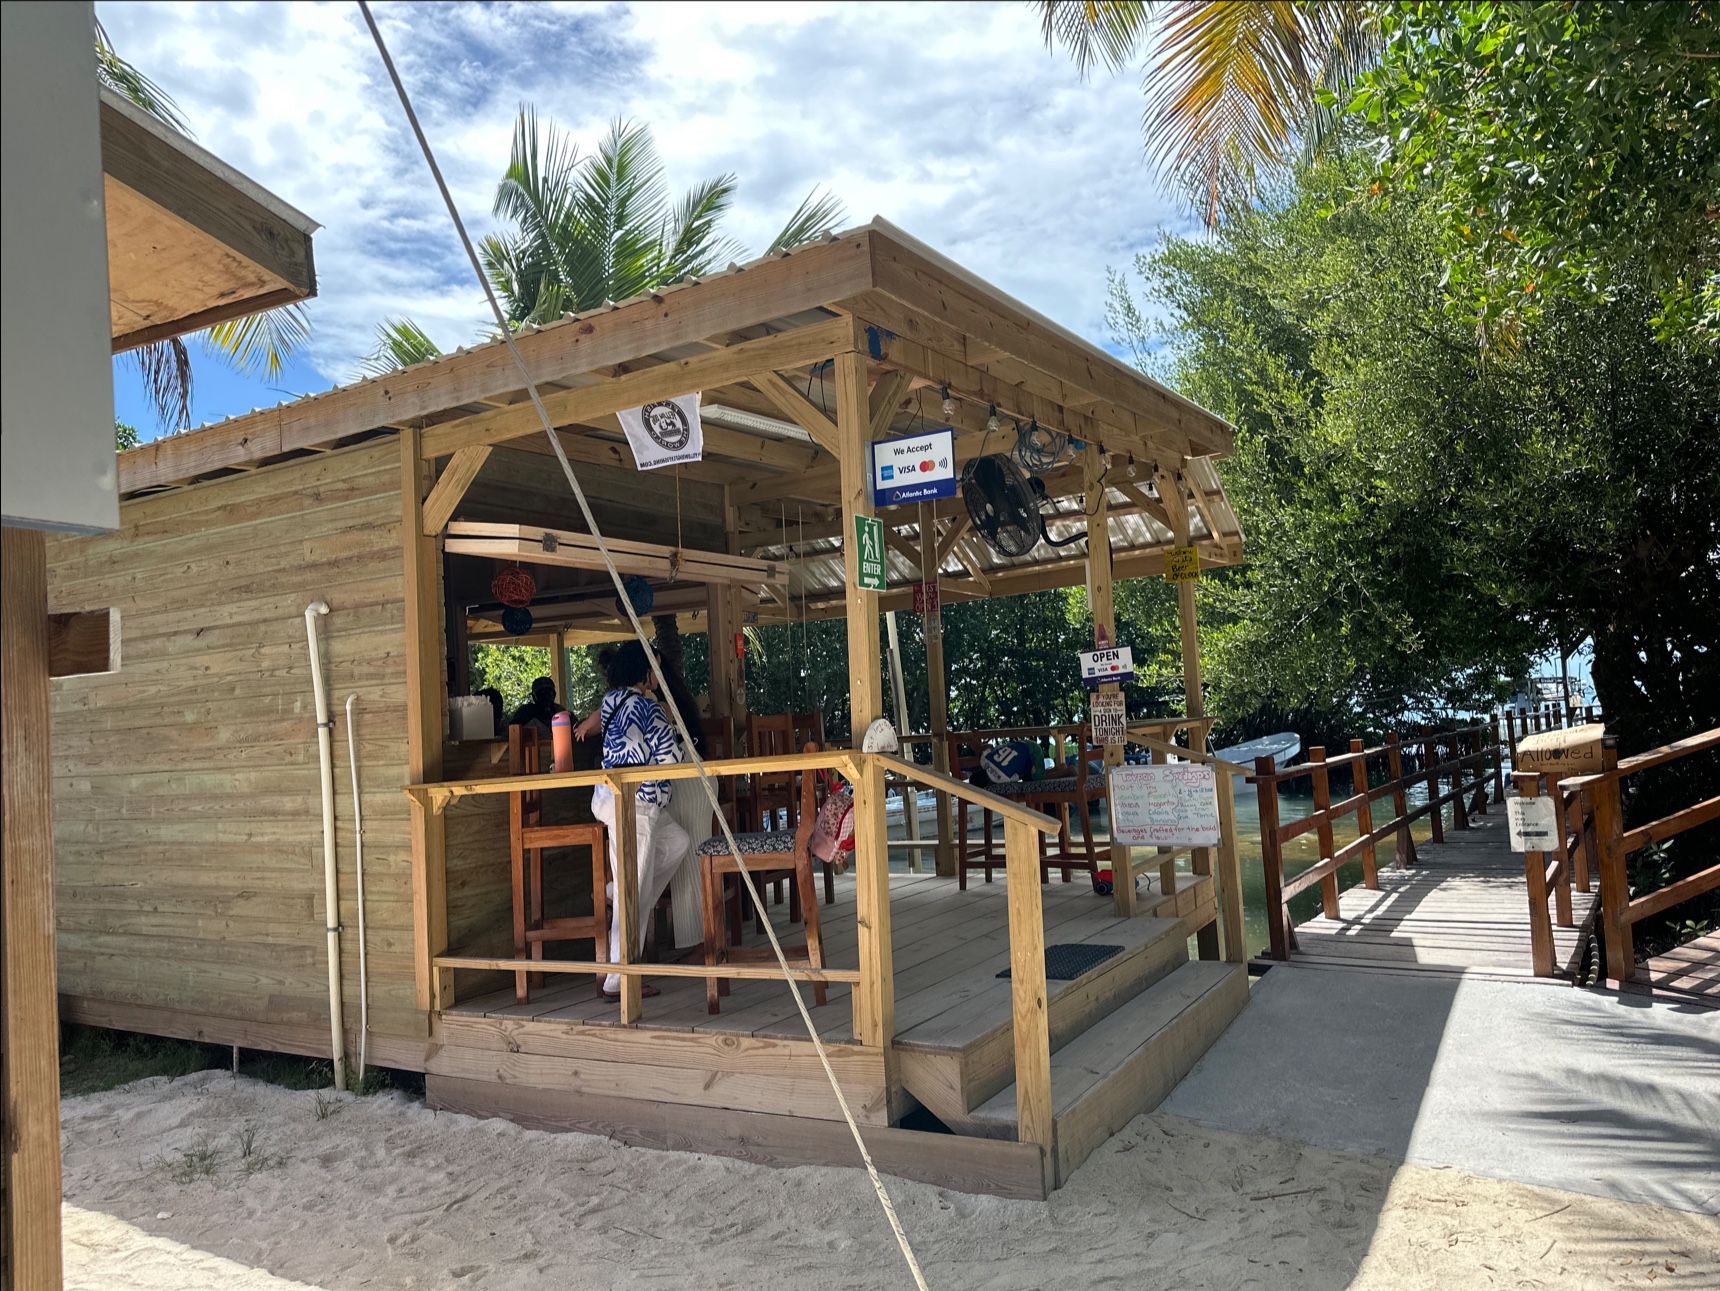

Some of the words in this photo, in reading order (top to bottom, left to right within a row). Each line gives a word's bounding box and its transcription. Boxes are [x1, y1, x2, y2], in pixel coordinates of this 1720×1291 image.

[893, 446, 905, 456] We
[906, 442, 933, 454] Accept
[897, 464, 916, 475] VISA
[901, 490, 922, 499] Atlantic
[923, 487, 938, 496] Bank
[862, 561, 882, 576] ENTER
[1092, 649, 1120, 663] OPEN
[1093, 713, 1124, 727] DRINK
[1096, 736, 1109, 744] THIS
[1110, 736, 1116, 744] IS
[1117, 736, 1125, 744] IT!
[993, 746, 1019, 767] 16
[1521, 746, 1593, 762] Allowed
[1116, 770, 1156, 789] Tarpon
[1162, 766, 1211, 788] Springs
[1186, 824, 1199, 832] the
[1200, 824, 1217, 832] bold
